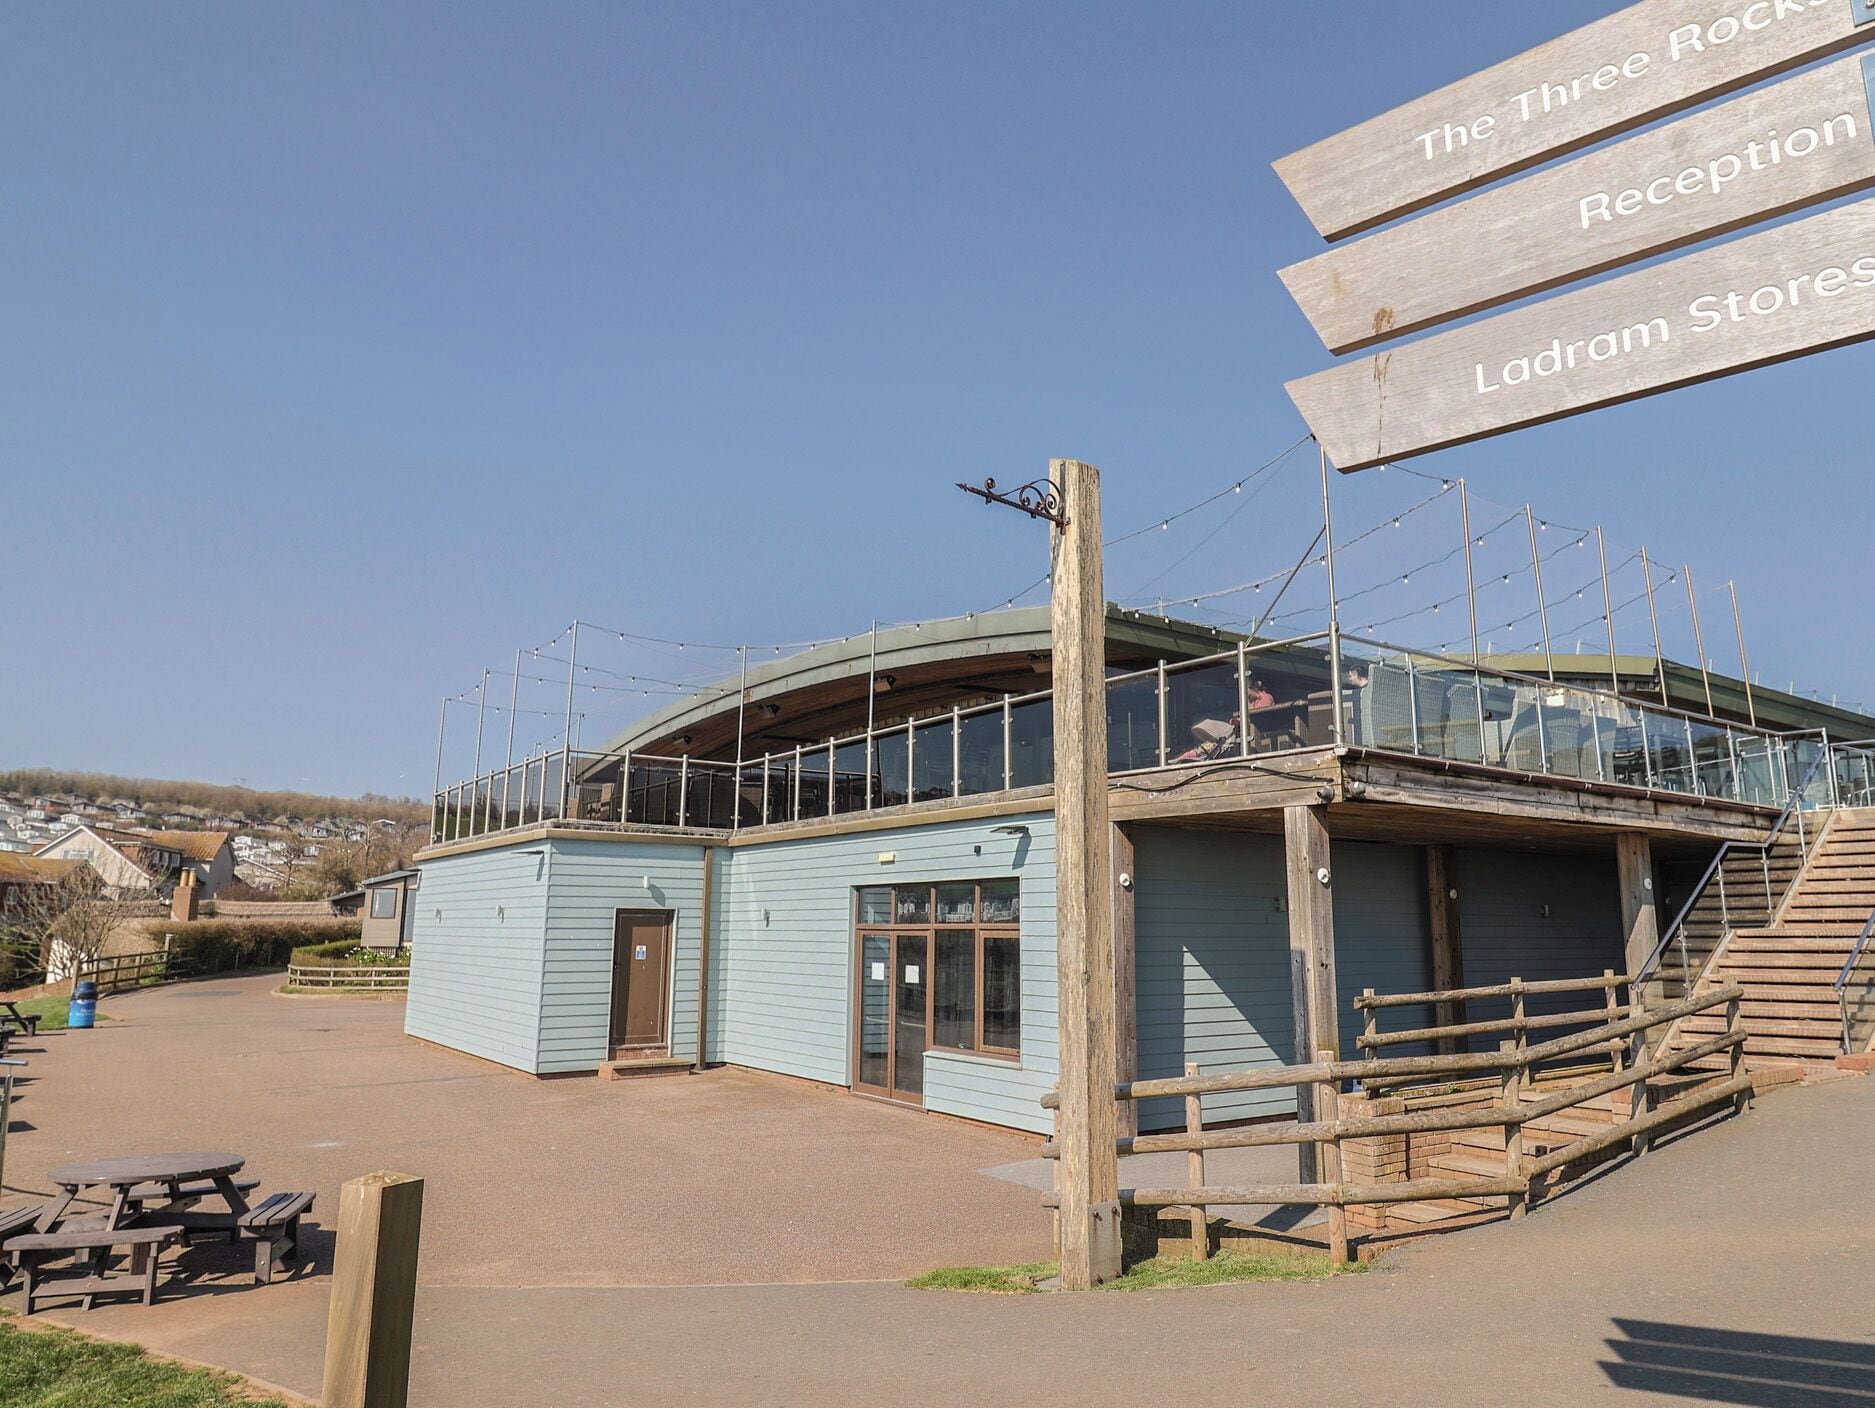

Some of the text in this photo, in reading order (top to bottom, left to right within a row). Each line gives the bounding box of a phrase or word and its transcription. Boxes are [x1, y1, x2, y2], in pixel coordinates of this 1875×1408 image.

[1415, 0, 1828, 161] The Three Rock
[1579, 112, 1857, 229] Reception
[1475, 256, 1875, 394] Ladram Stores
